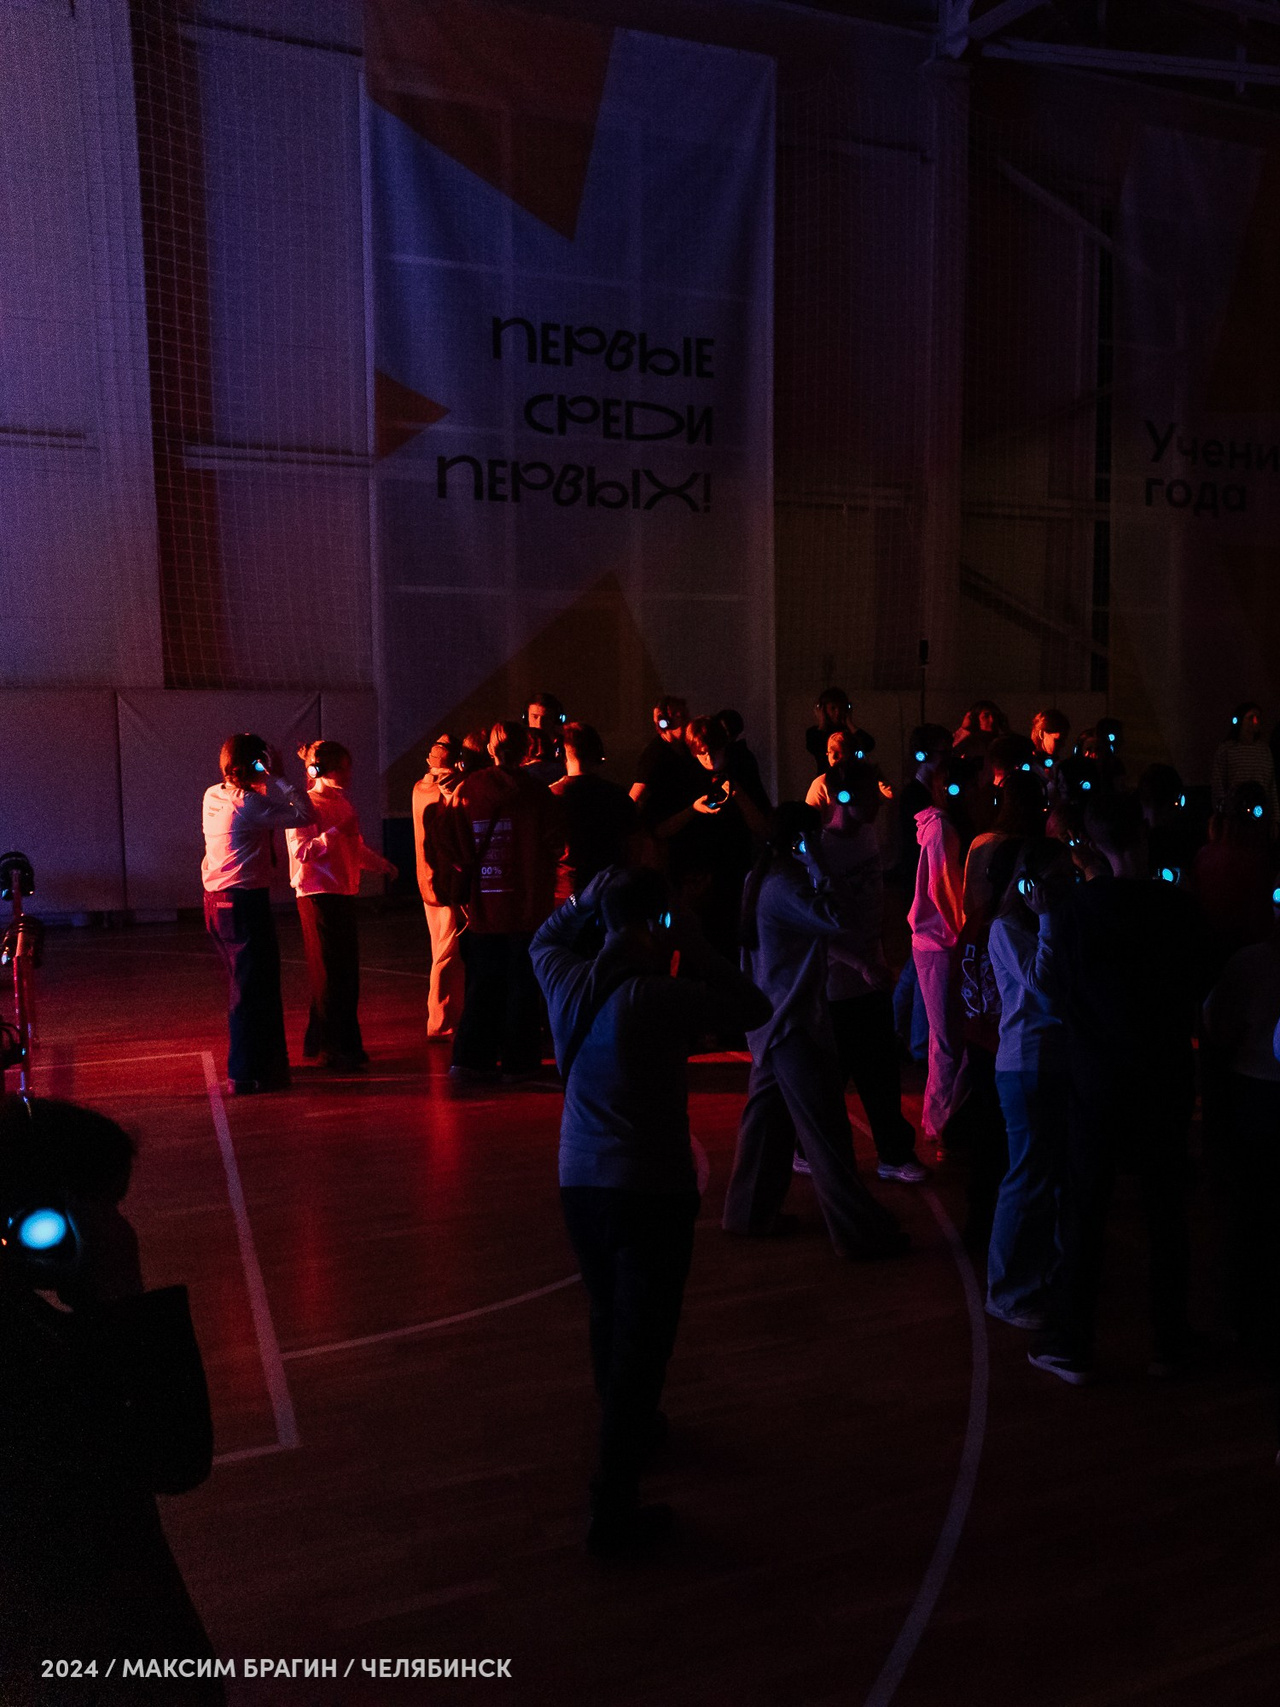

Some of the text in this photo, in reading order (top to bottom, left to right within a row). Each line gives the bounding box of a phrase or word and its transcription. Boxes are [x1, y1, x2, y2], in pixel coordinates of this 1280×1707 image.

[492, 317, 714, 378] ПЕРВЫЕ
[524, 394, 712, 446] СРЕДИ
[437, 455, 711, 513] ПЕРВЫХ!
[1145, 477, 1247, 517] года
